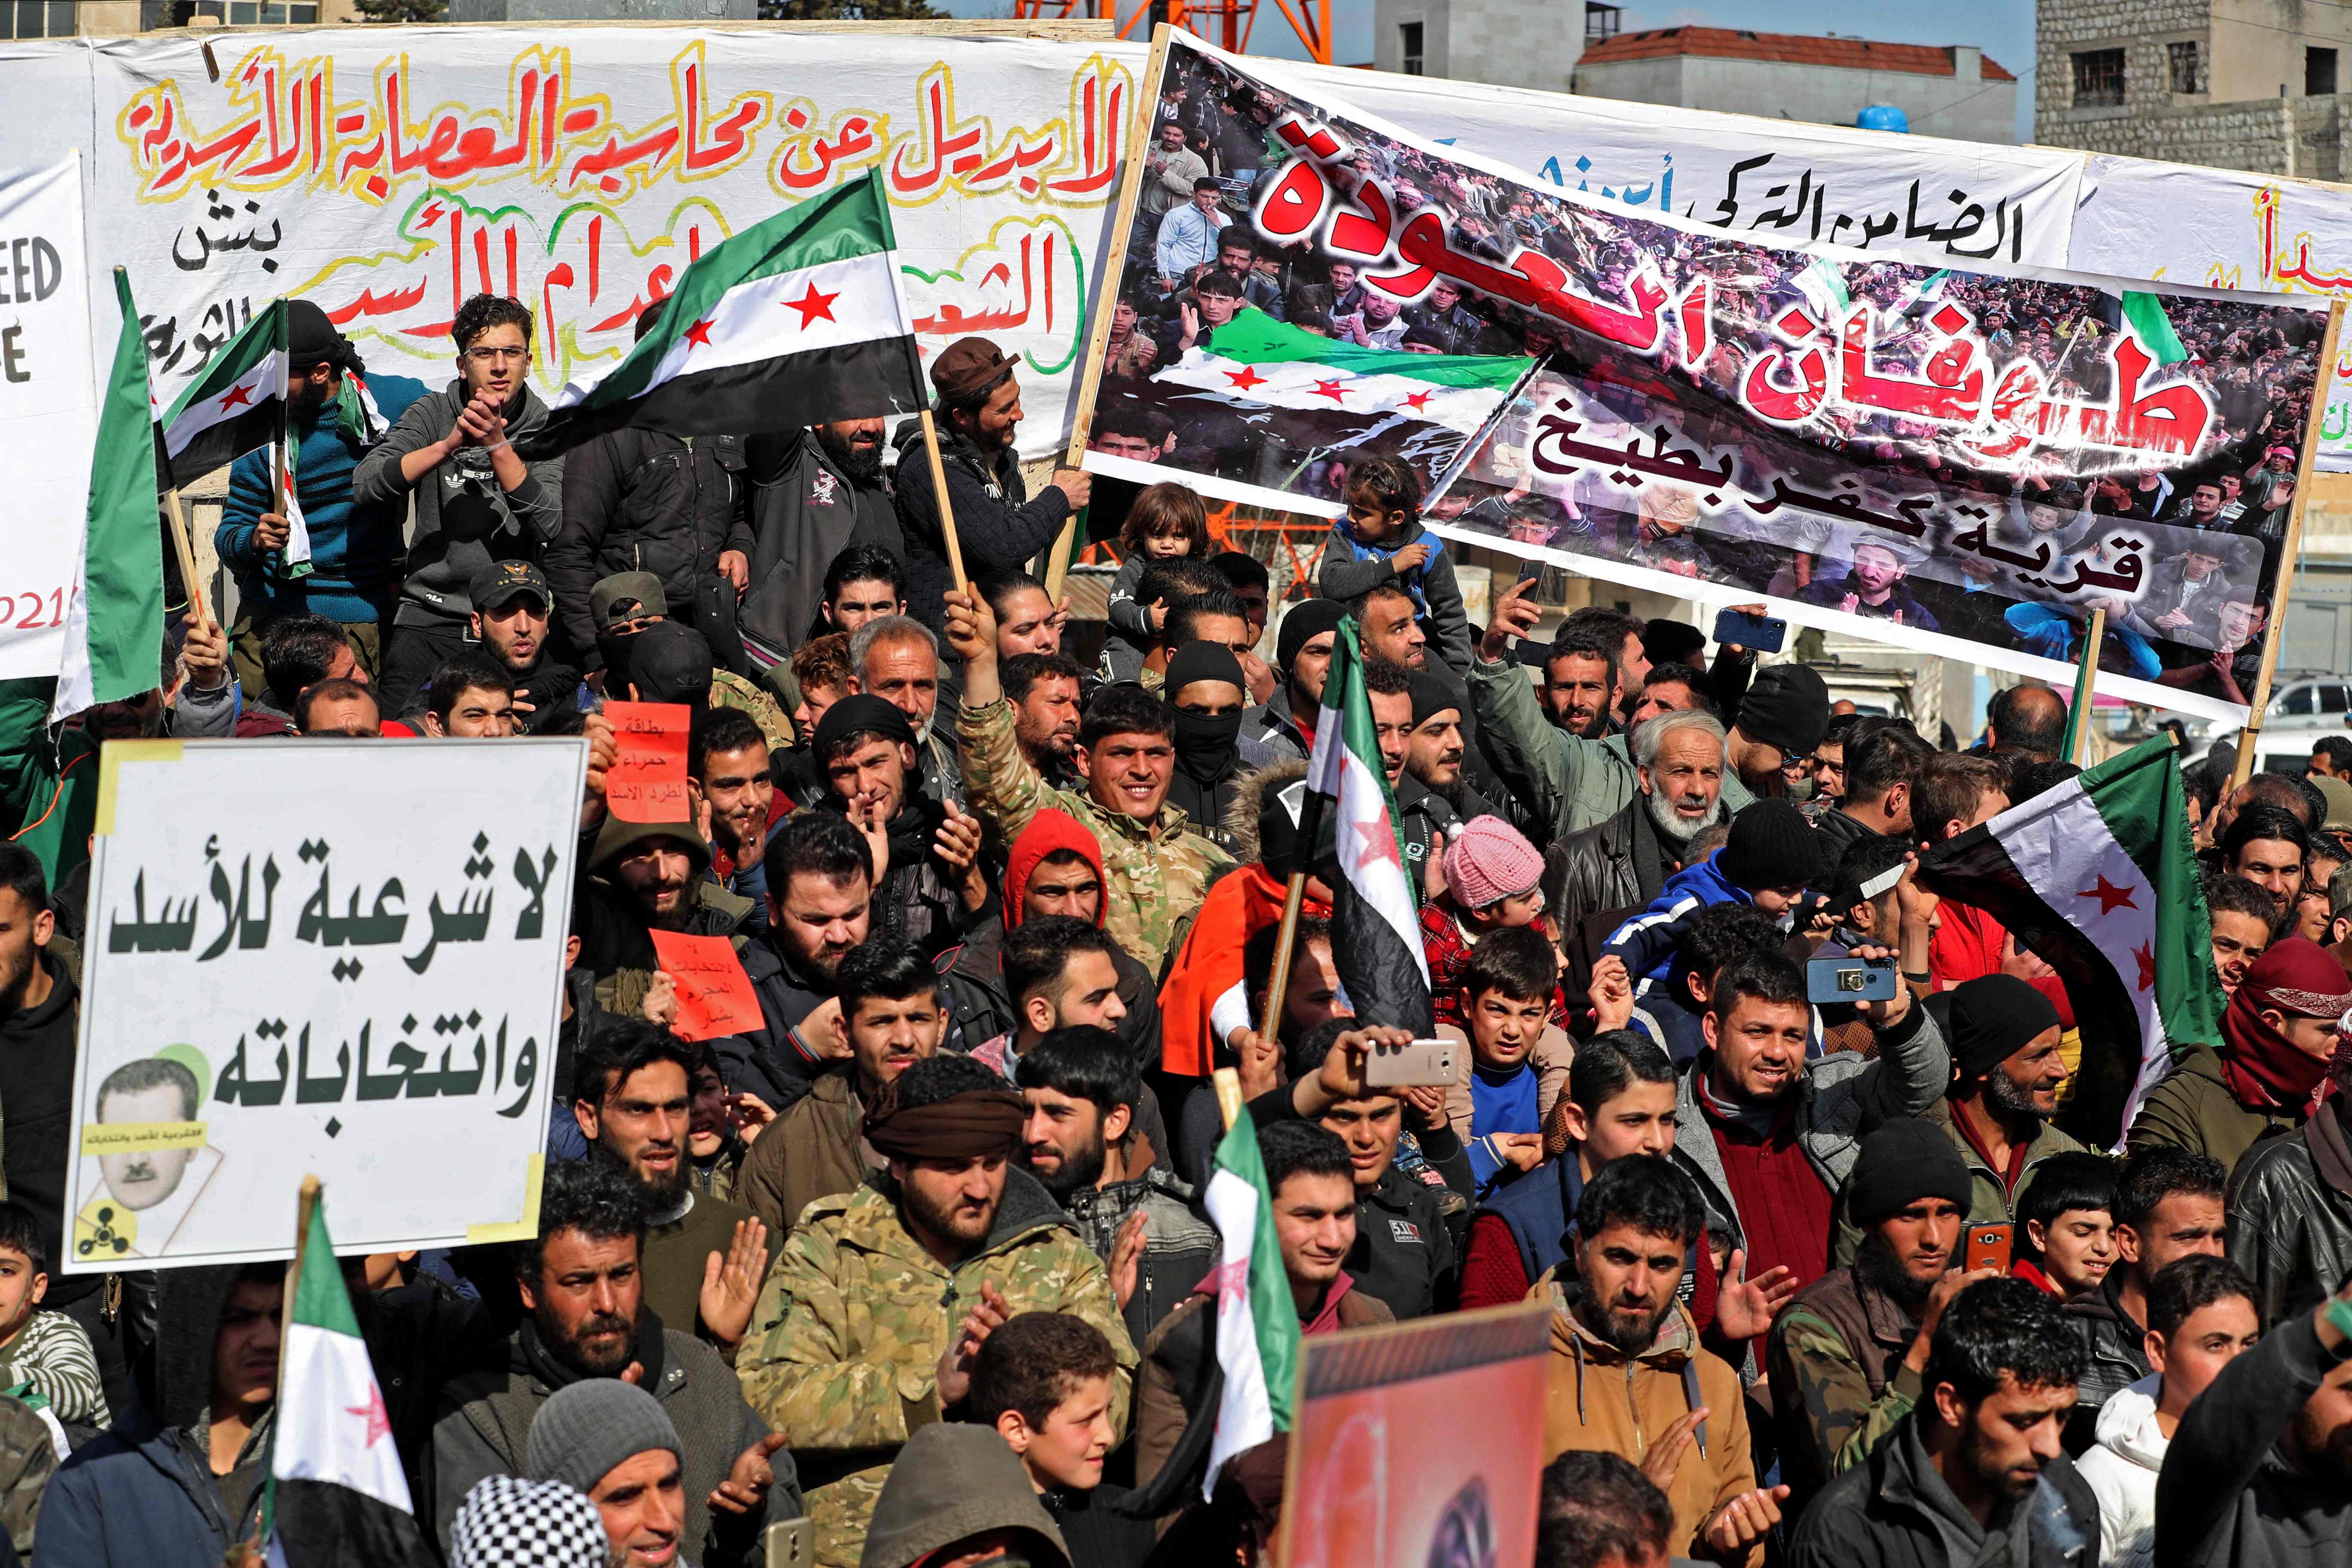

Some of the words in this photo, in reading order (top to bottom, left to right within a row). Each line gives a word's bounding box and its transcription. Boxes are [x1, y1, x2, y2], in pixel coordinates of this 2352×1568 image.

[131, 63, 322, 189] الأسدية
[337, 71, 558, 198] العصابة
[564, 64, 760, 192] محاسبة
[781, 109, 872, 188] عن
[892, 82, 1053, 192] بديل
[1047, 76, 1122, 193] لا
[172, 189, 282, 274] بنش
[1262, 120, 1706, 364] العودة
[1747, 303, 2208, 457] طوفان
[1532, 398, 1734, 507] بطيخ
[1744, 477, 1934, 537] كفر
[1952, 504, 2144, 594] قرية
[624, 753, 666, 770] حمراء
[626, 717, 665, 738] بطاقة
[650, 784, 681, 802] لطرد
[108, 834, 281, 962] للأسد
[296, 830, 493, 981] شرعية
[514, 844, 558, 940] لا
[687, 944, 698, 954] لا
[687, 982, 734, 1004] المجرم
[701, 1006, 734, 1030] بشار
[213, 1009, 538, 1139] وانتخاباته
